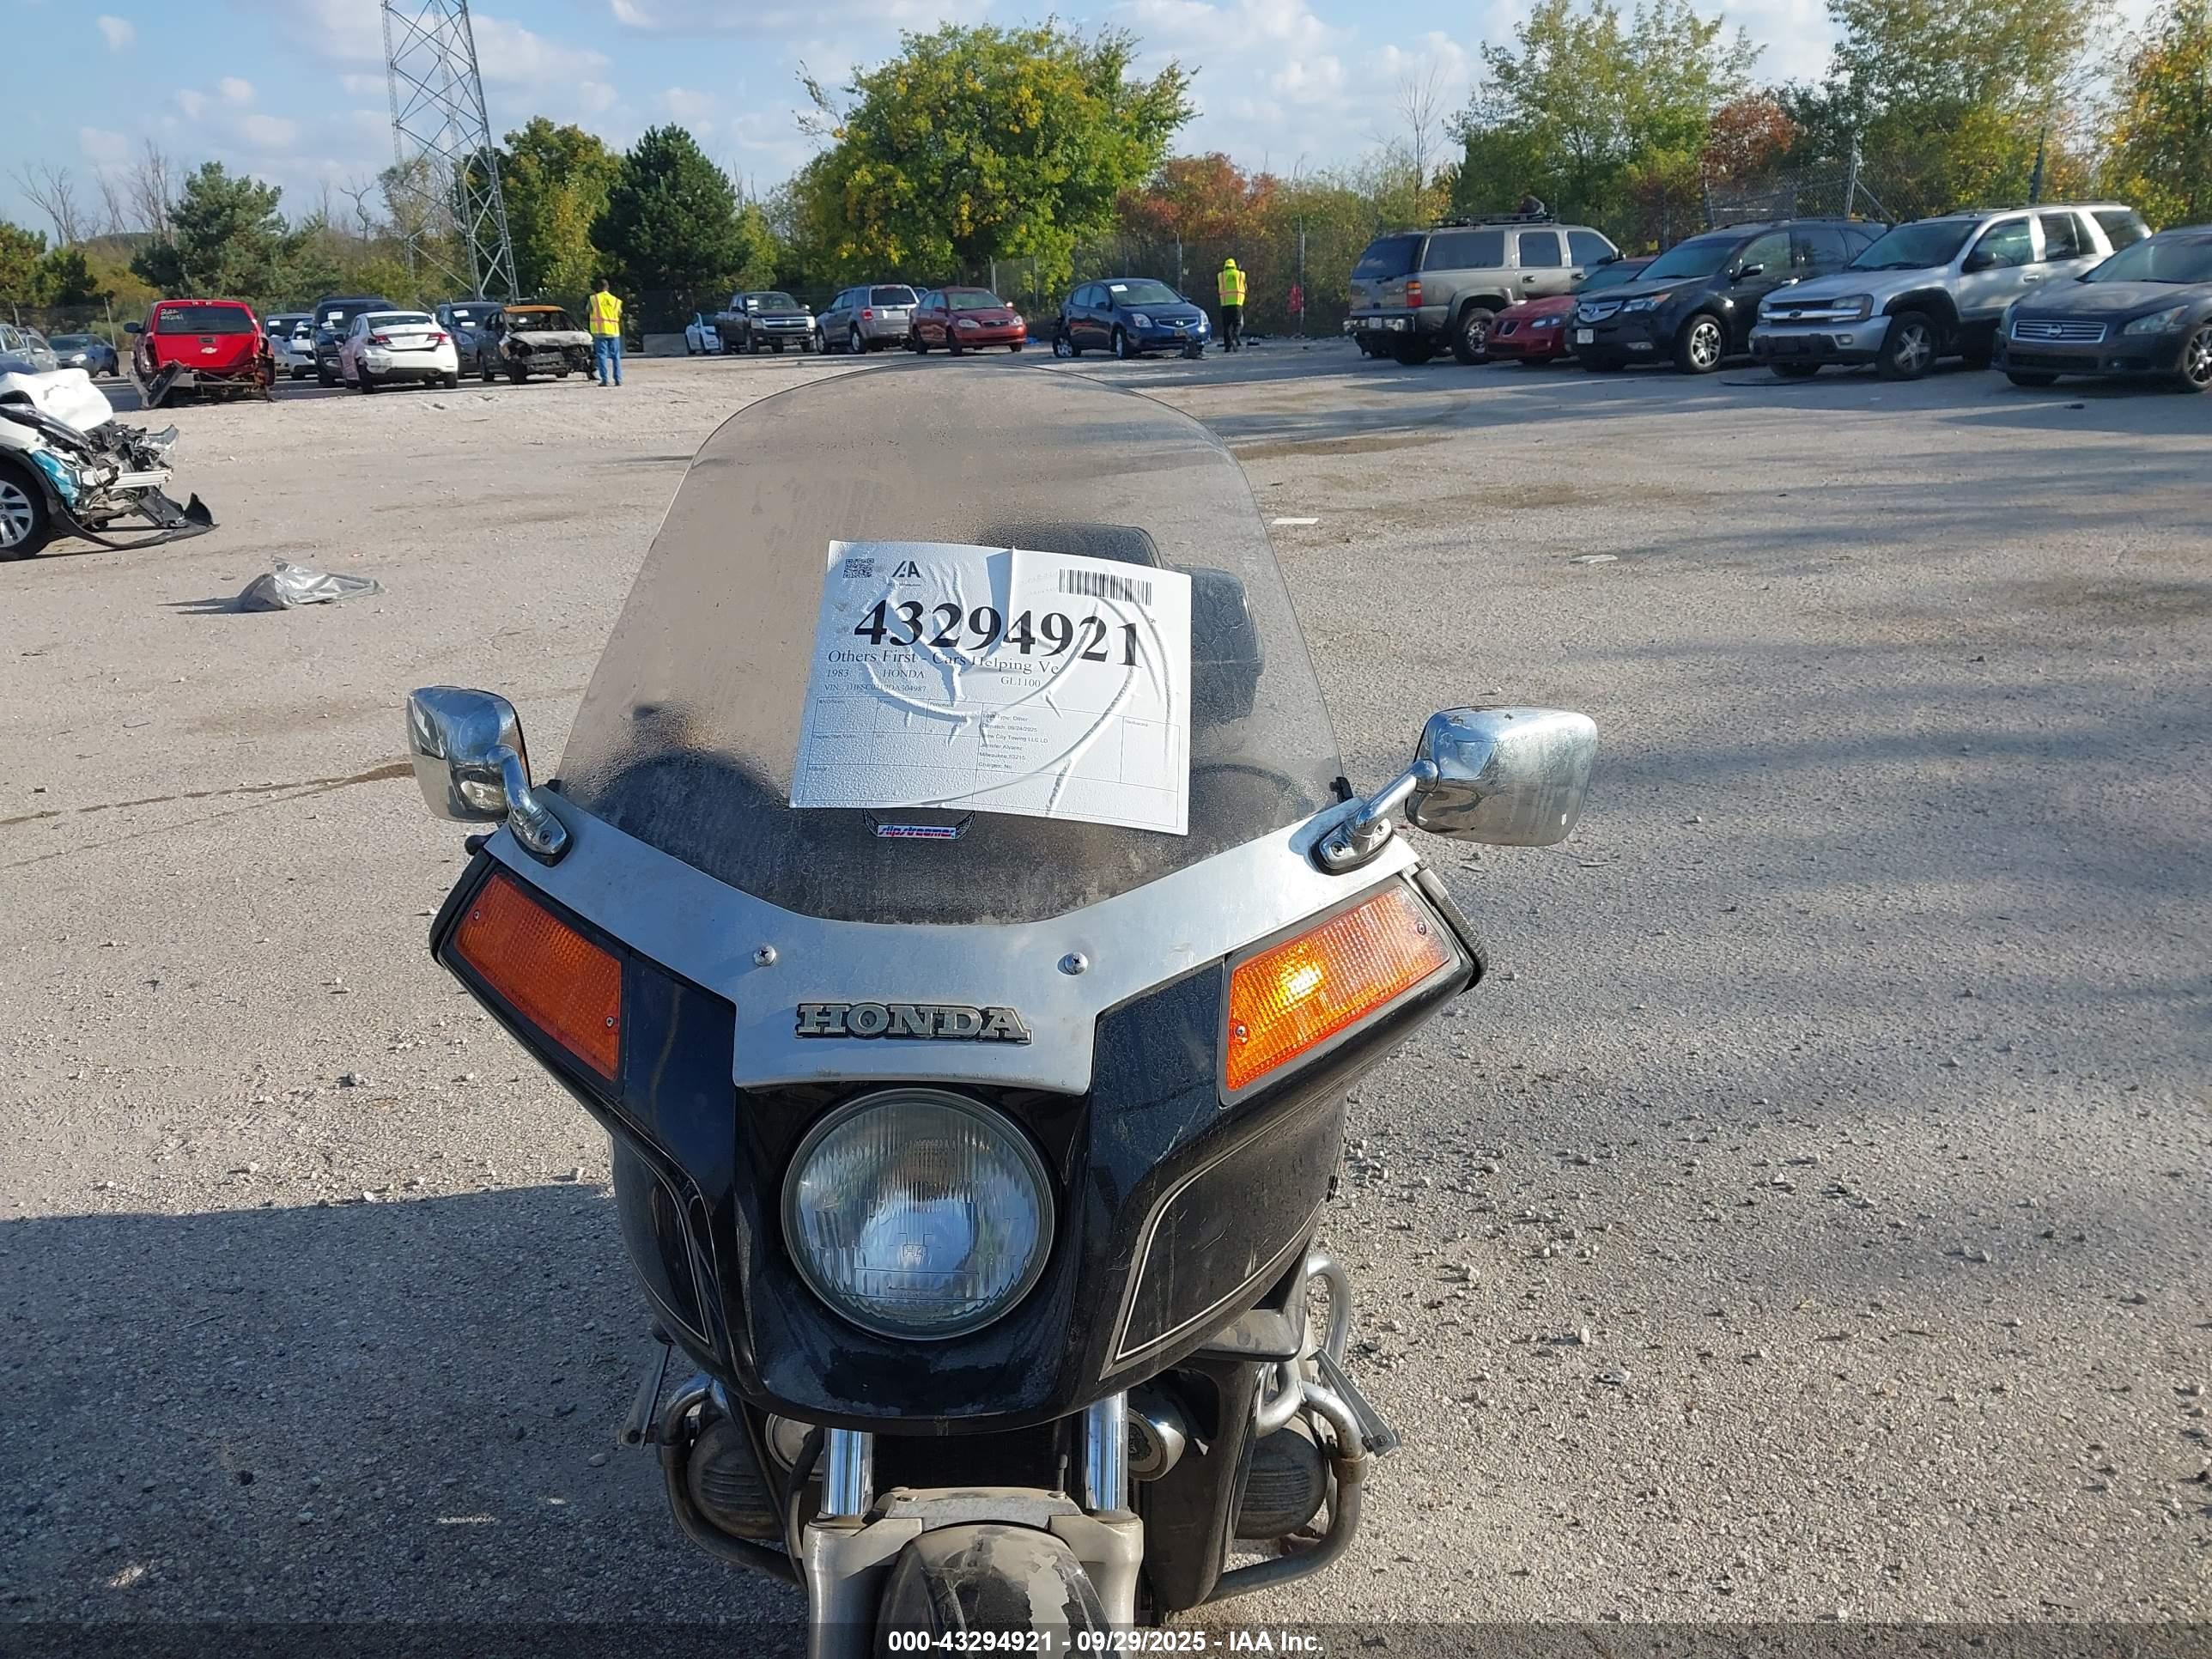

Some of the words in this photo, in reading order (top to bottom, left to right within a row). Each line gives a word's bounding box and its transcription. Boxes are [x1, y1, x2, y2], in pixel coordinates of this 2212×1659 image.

[854, 599, 1143, 668] 43294921
[828, 650, 877, 663] Others
[883, 650, 916, 664] First
[933, 652, 967, 666] Cars
[971, 656, 1032, 675] Helping
[883, 670, 925, 679] HONDA
[1000, 676, 1041, 688] GL1100
[795, 1002, 1034, 1044] HONDA
[906, 1245, 924, 1256] H4
